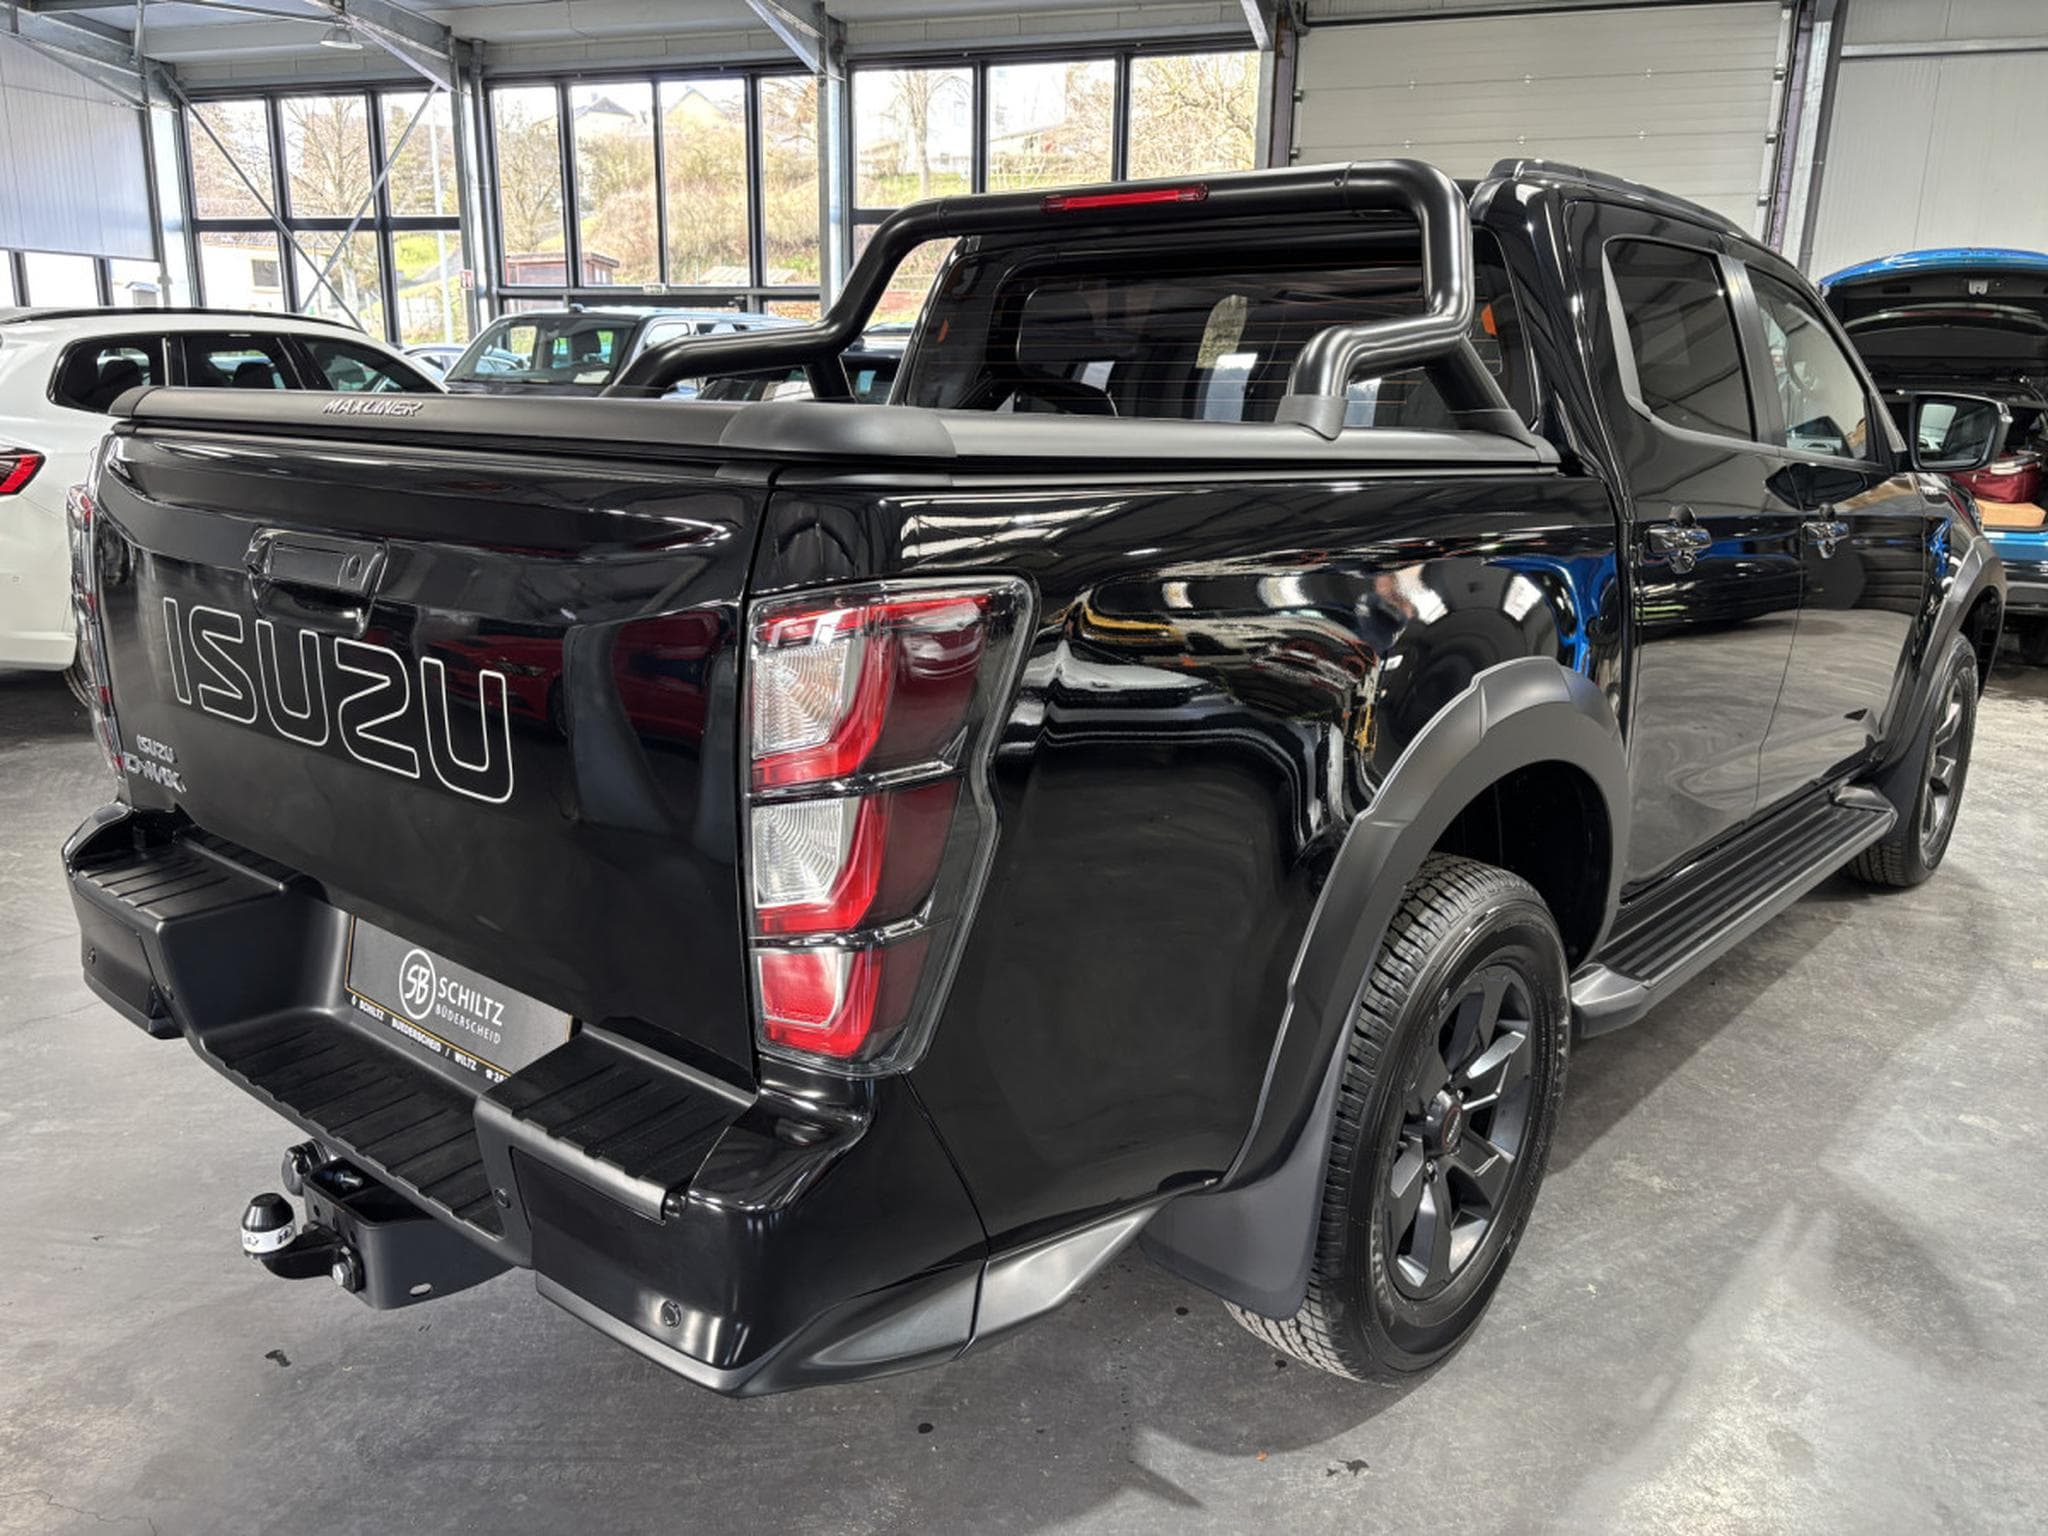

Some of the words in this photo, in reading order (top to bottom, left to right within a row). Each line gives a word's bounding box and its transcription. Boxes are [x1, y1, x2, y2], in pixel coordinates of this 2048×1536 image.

[322, 399, 424, 416] MAXLINER
[163, 597, 513, 803] ISUZU
[136, 734, 175, 763] ISUZU
[438, 977, 505, 1026] SCHILTZ
